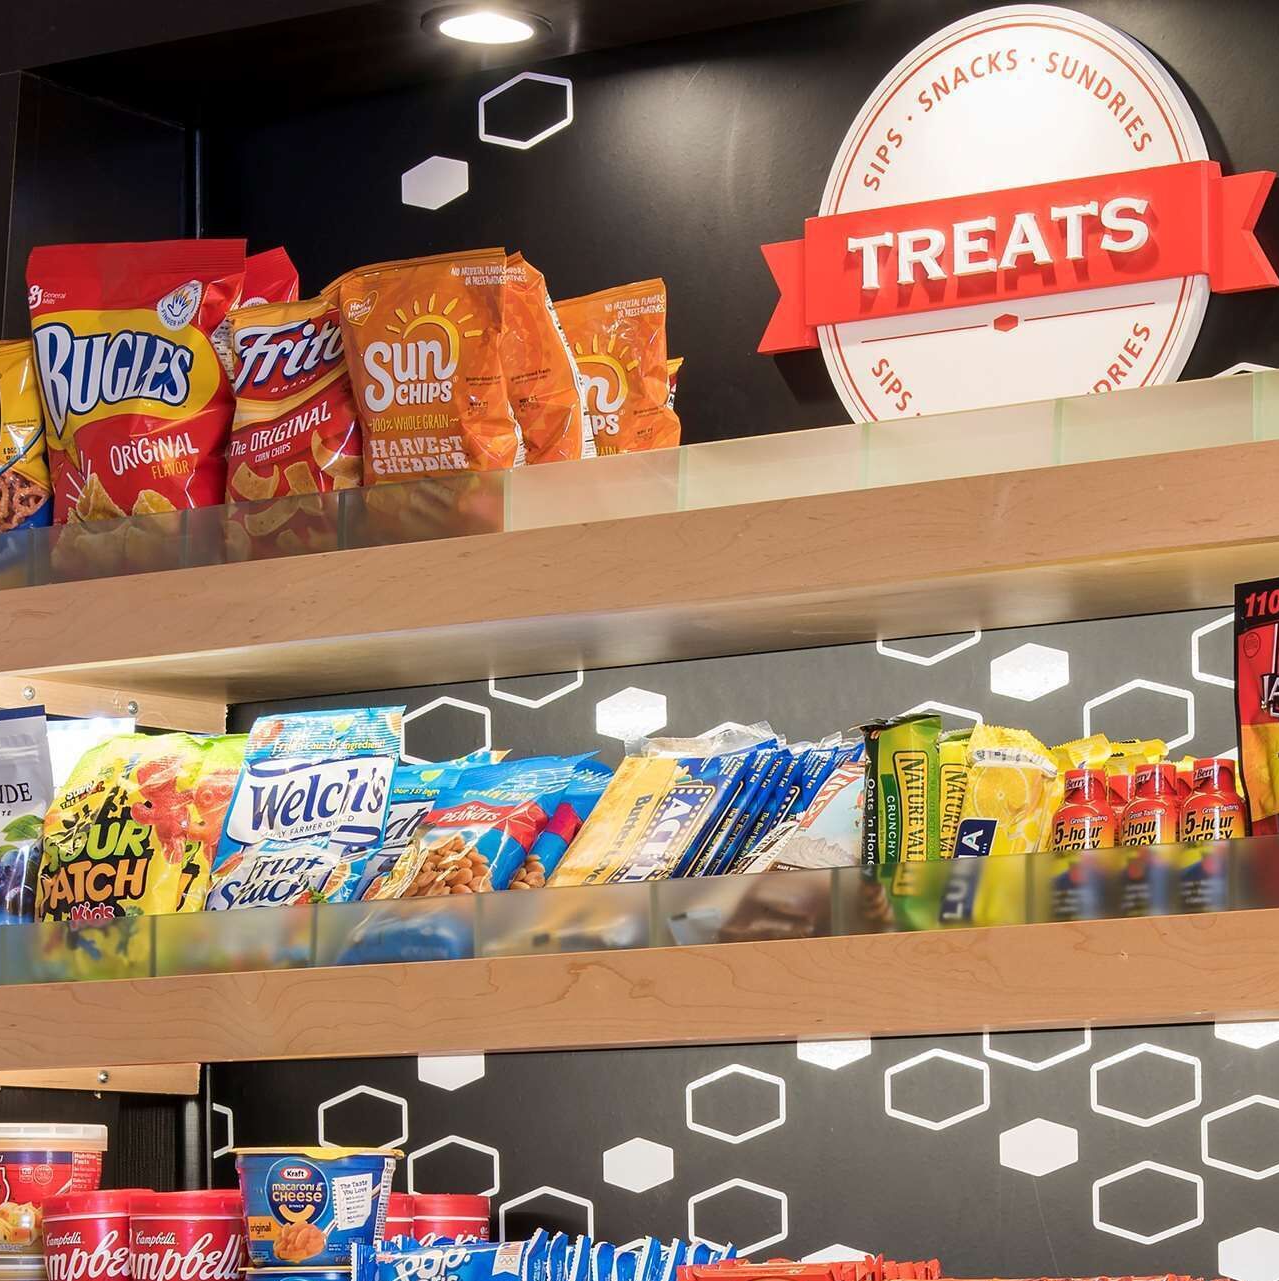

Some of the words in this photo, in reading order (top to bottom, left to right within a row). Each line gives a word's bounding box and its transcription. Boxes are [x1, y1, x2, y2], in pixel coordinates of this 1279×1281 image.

[864, 129, 902, 191] SIPS
[918, 49, 1018, 112] SNACKS
[1046, 52, 1152, 152] SUNDRIES
[848, 197, 1149, 290] TREATS
[33, 324, 194, 440] BUGLES
[364, 335, 459, 412] Sun
[872, 358, 913, 411] SIPS
[396, 381, 452, 405] CHIPS
[231, 438, 247, 457] The
[250, 401, 331, 450] ORIGINAL
[394, 416, 422, 431] WHOLE
[423, 414, 449, 430] GRAIN
[271, 443, 292, 458] CHIPS
[370, 436, 462, 458] HARVEST
[151, 461, 190, 480] FLAVOR
[373, 452, 469, 474] CHEDDAR
[250, 767, 386, 831] Welch's
[866, 778, 876, 811] Oats
[900, 758, 925, 826] NATURE
[438, 810, 502, 823] PEANUTS
[887, 795, 897, 857] CRUNCHY
[1184, 811, 1234, 835] 5-hour
[290, 823, 322, 837] FARMER
[1054, 821, 1102, 845] 5-hour
[286, 1170, 305, 1178] Kraft
[353, 1180, 368, 1188] Taste
[272, 1182, 315, 1192] macaroni
[46, 1232, 81, 1246] Campbell's
[136, 1232, 176, 1245] Campbell's
